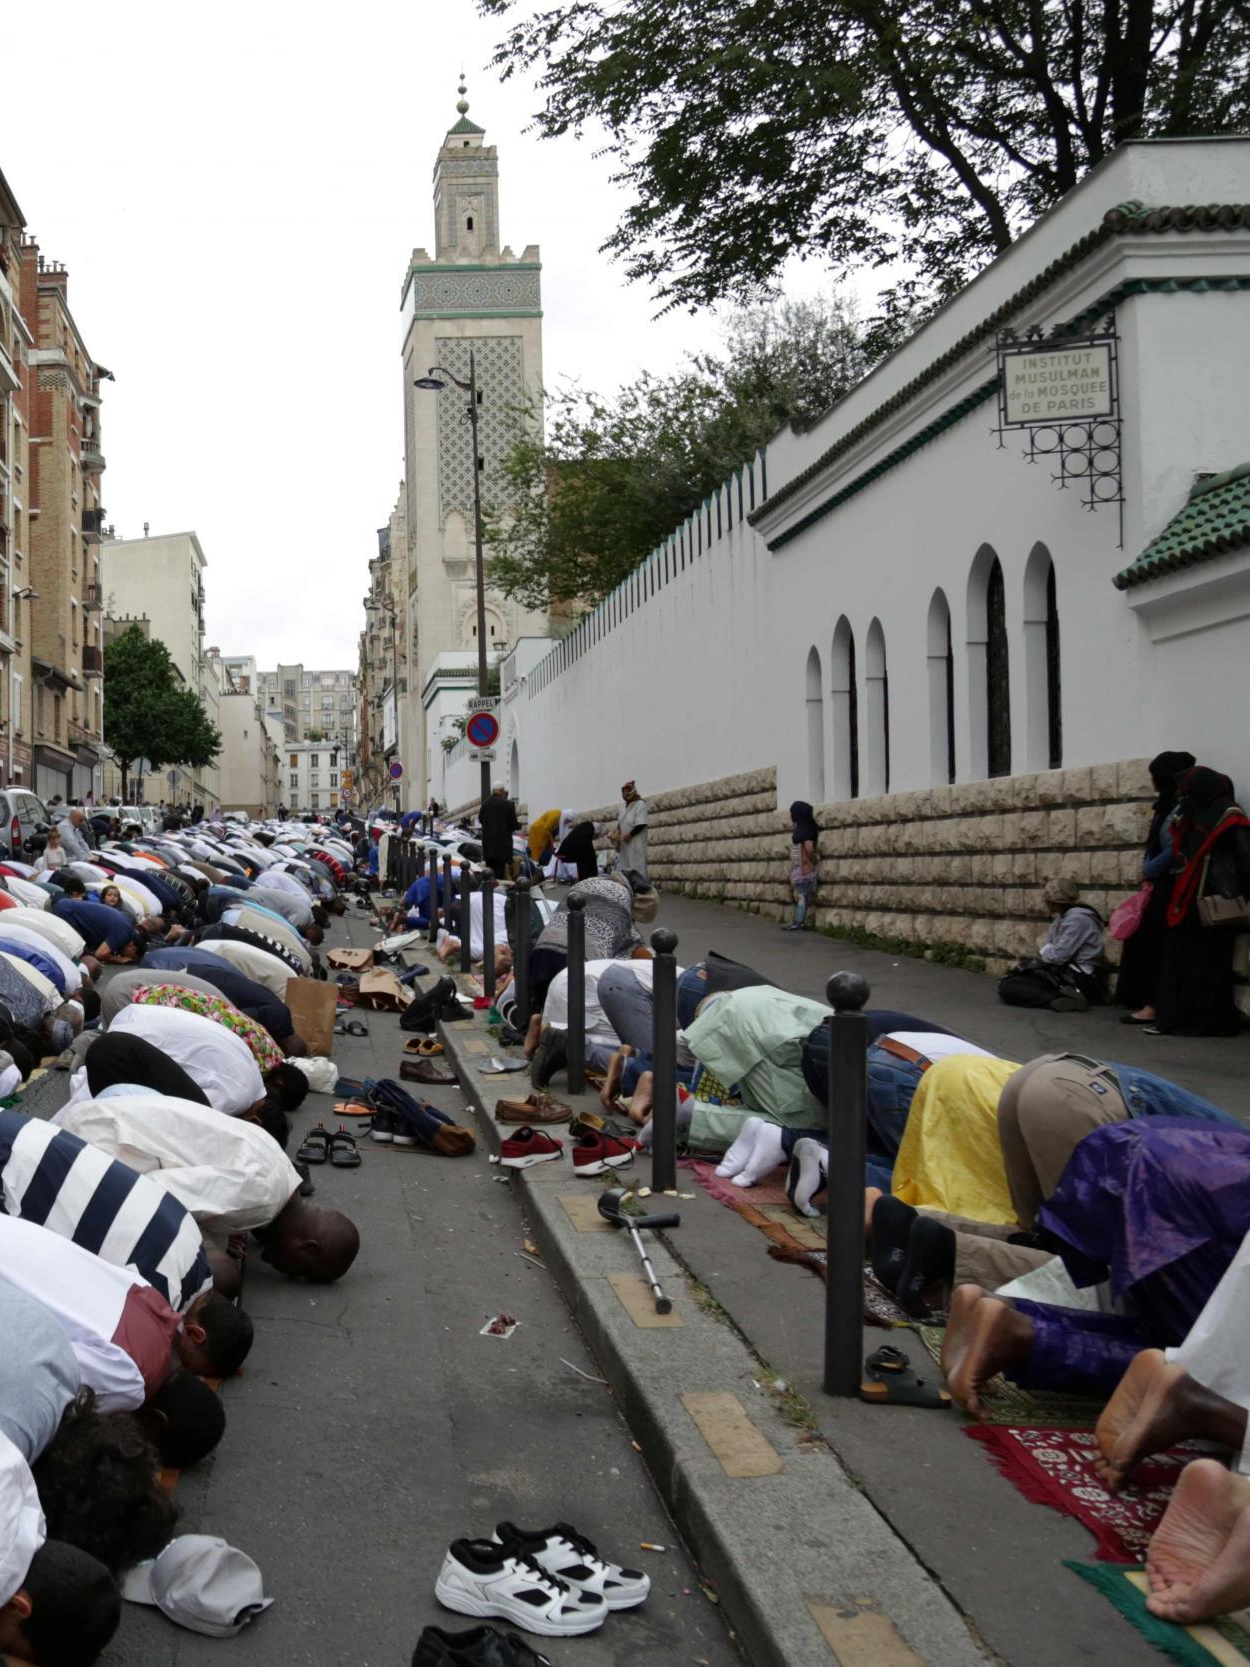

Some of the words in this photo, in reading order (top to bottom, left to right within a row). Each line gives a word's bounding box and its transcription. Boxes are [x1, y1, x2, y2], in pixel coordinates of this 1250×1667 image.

[1022, 353, 1093, 370] INSTITUT
[1015, 367, 1100, 385] MUSULMAN
[1009, 391, 1021, 401] de
[1024, 388, 1035, 399] la
[1022, 402, 1041, 414] DE
[1047, 397, 1096, 413] PARIS
[468, 699, 494, 709] RAPPEL
